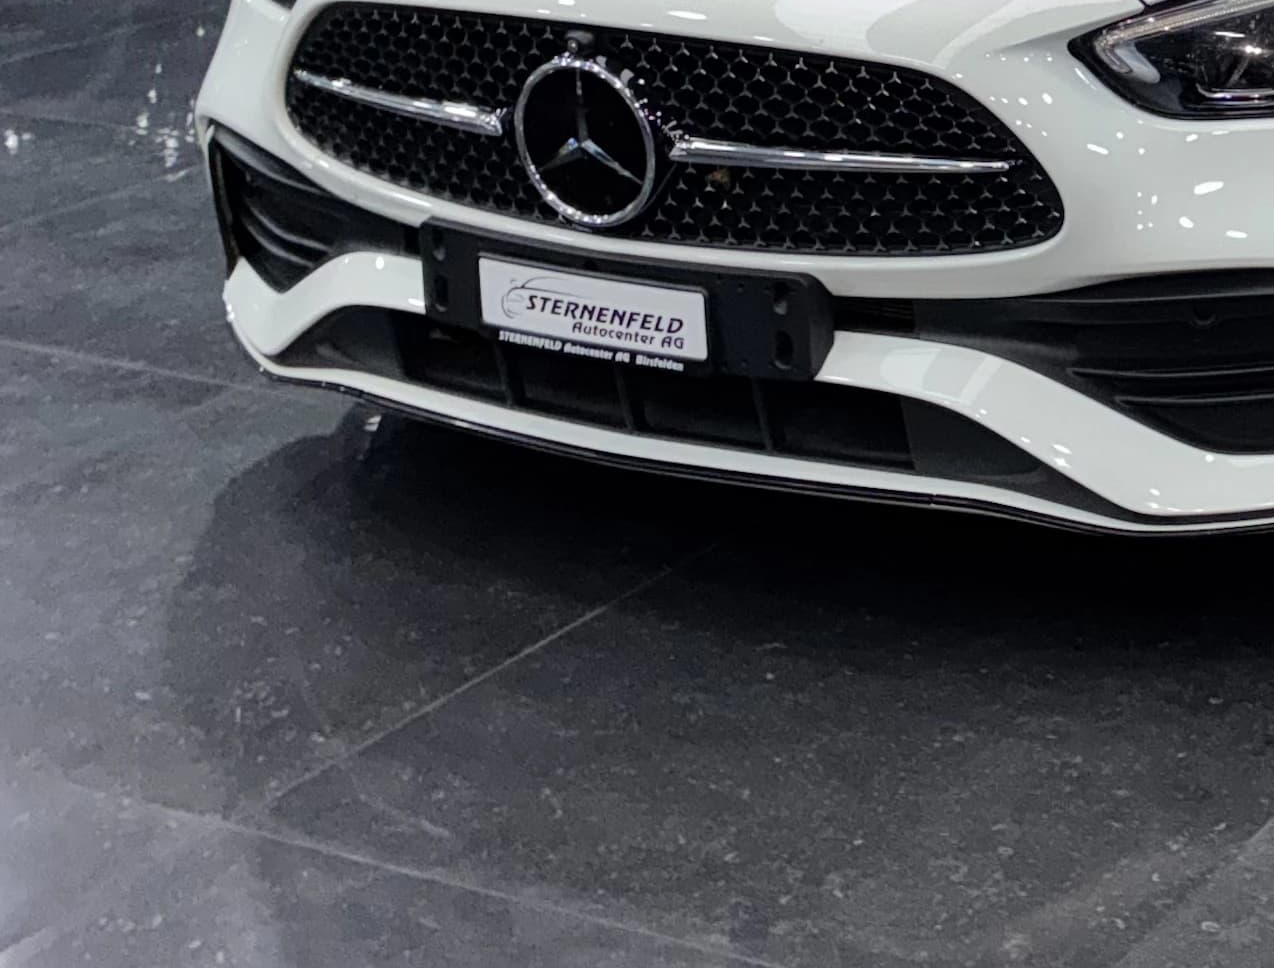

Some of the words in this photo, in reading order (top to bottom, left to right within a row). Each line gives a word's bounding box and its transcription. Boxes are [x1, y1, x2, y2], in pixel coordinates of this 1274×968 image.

[526, 295, 684, 334] STERNENFELD
[572, 321, 656, 345] Autocenter
[661, 335, 685, 350] AG
